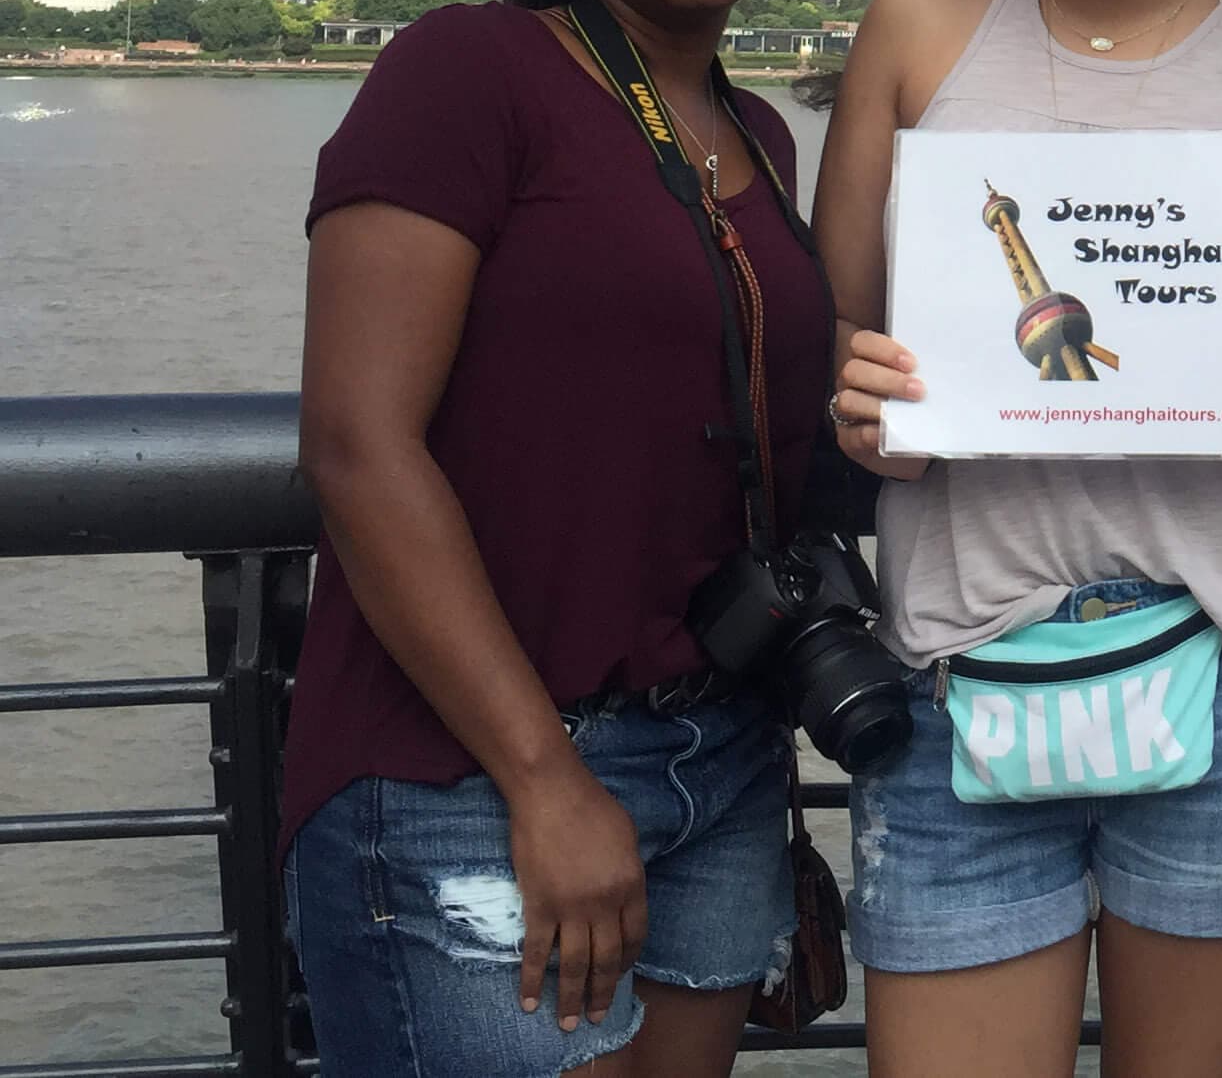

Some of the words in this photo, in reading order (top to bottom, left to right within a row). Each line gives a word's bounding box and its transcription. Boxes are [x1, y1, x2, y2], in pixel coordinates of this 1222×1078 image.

[629, 82, 674, 143] Nikon
[1047, 197, 1186, 229] Jenny's
[1115, 278, 1217, 304] Tours
[967, 667, 1185, 786] PINK
